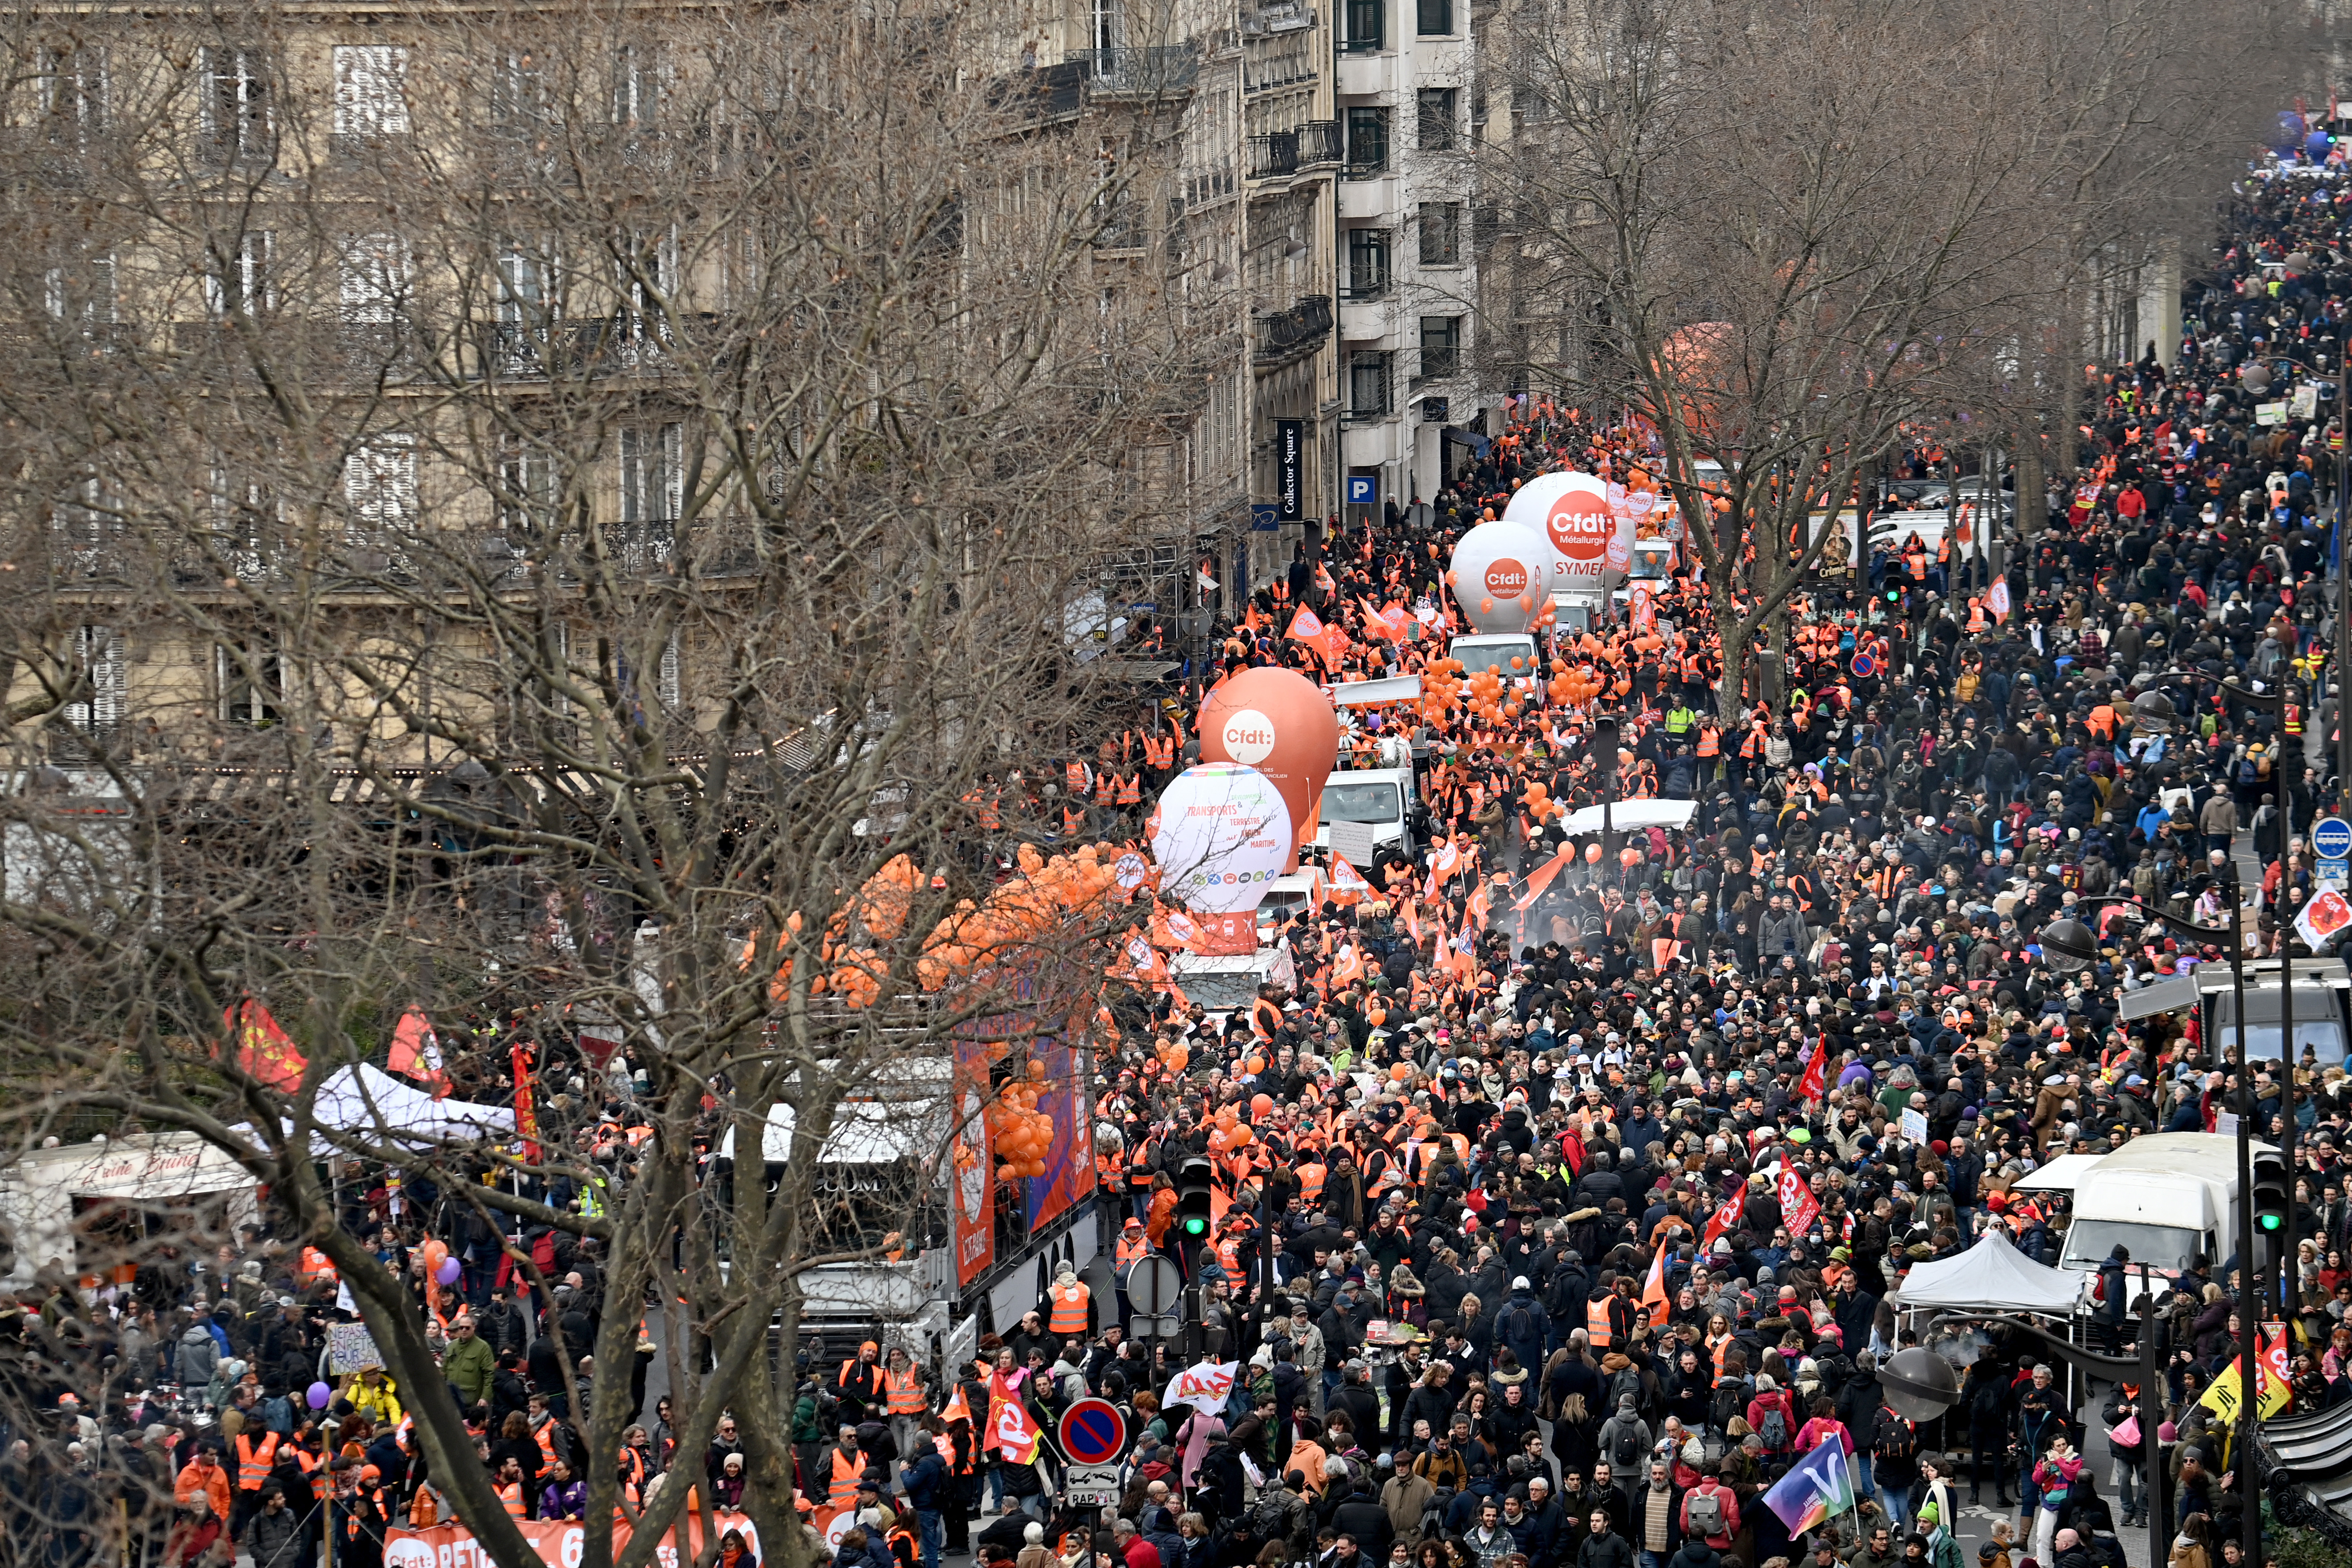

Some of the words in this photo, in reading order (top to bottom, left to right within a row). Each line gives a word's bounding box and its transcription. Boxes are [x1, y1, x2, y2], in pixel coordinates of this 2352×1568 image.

[1284, 428, 1296, 464] Square
[1285, 466, 1294, 514] Collector
[1353, 481, 1368, 498] P
[1552, 513, 1613, 532] Cfdt:
[1559, 536, 1606, 546] Métallurgie
[1100, 571, 1116, 580] BUS
[1819, 566, 1847, 578] Crime
[1487, 573, 1524, 584] Cfdt:
[1297, 617, 1320, 633] Cfdt:
[1227, 728, 1271, 745] Cfdt:
[1188, 805, 1237, 816] TRANSPORTS
[1230, 817, 1261, 826] TERRESTRE
[1250, 839, 1275, 849] MARITIME
[1201, 923, 1217, 933] erre
[1904, 1127, 1911, 1138] EN
[330, 1339, 345, 1352] EN
[329, 1349, 359, 1363] POUR
[1072, 1493, 1115, 1504] RAPL
